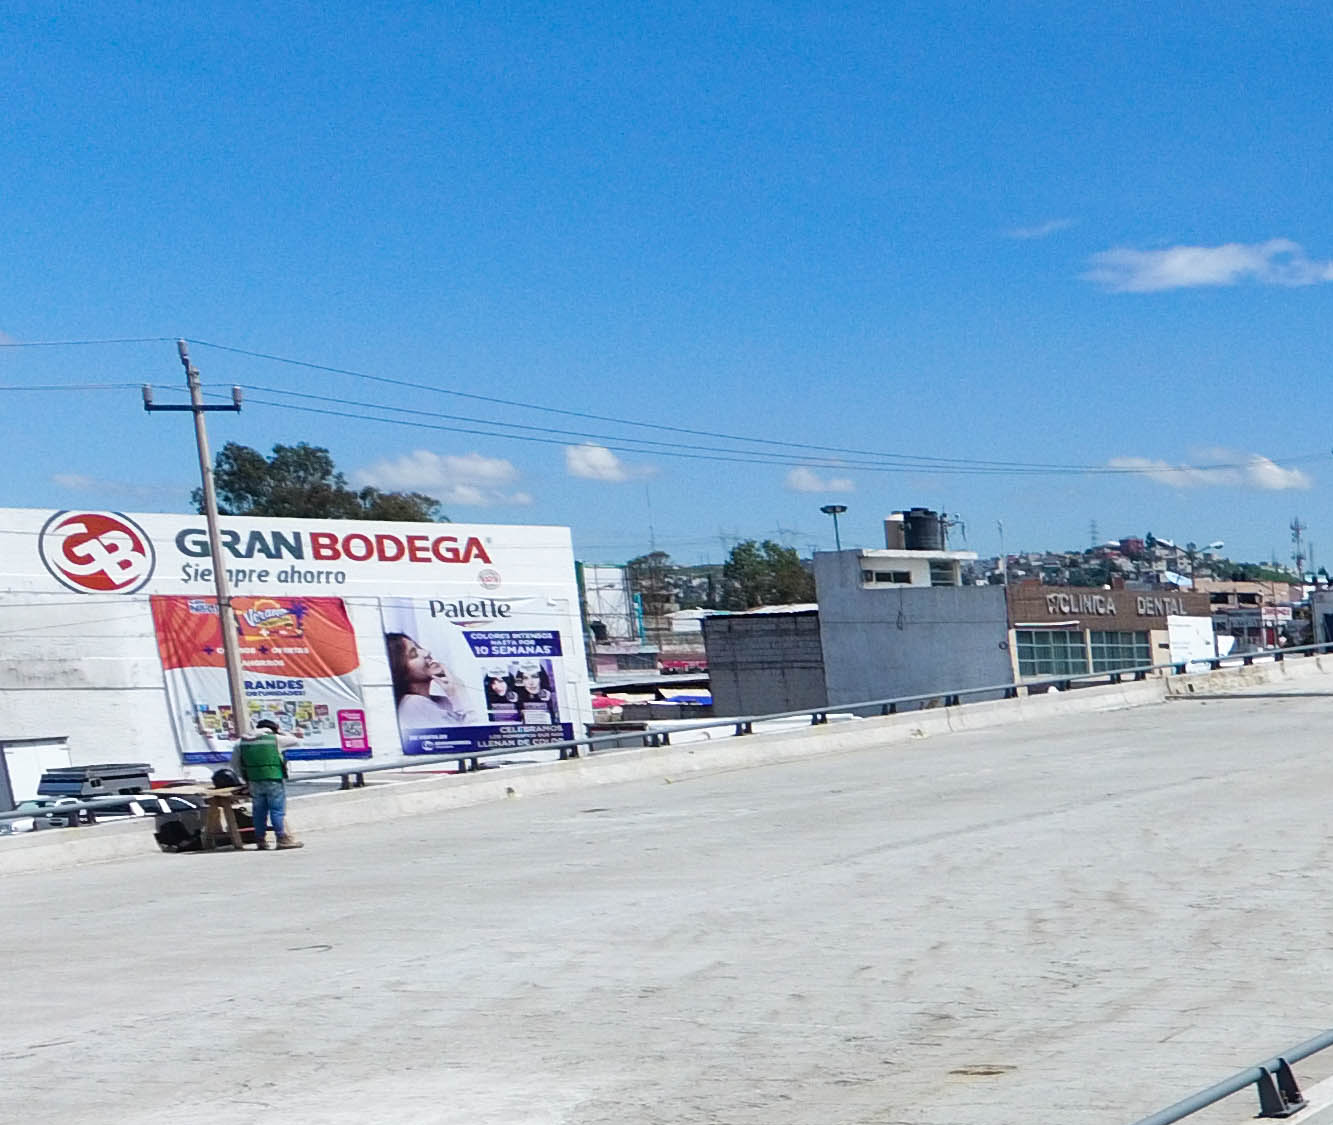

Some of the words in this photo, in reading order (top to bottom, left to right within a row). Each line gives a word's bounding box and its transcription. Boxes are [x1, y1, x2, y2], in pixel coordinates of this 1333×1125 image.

[309, 532, 492, 564] BODEGA
[277, 564, 346, 584] ahorro
[429, 600, 512, 618] Palette
[1137, 596, 1188, 616] DENTAL
[474, 646, 489, 655] 10
[491, 646, 552, 655] SEMANAS
[244, 680, 304, 690] RANDES
